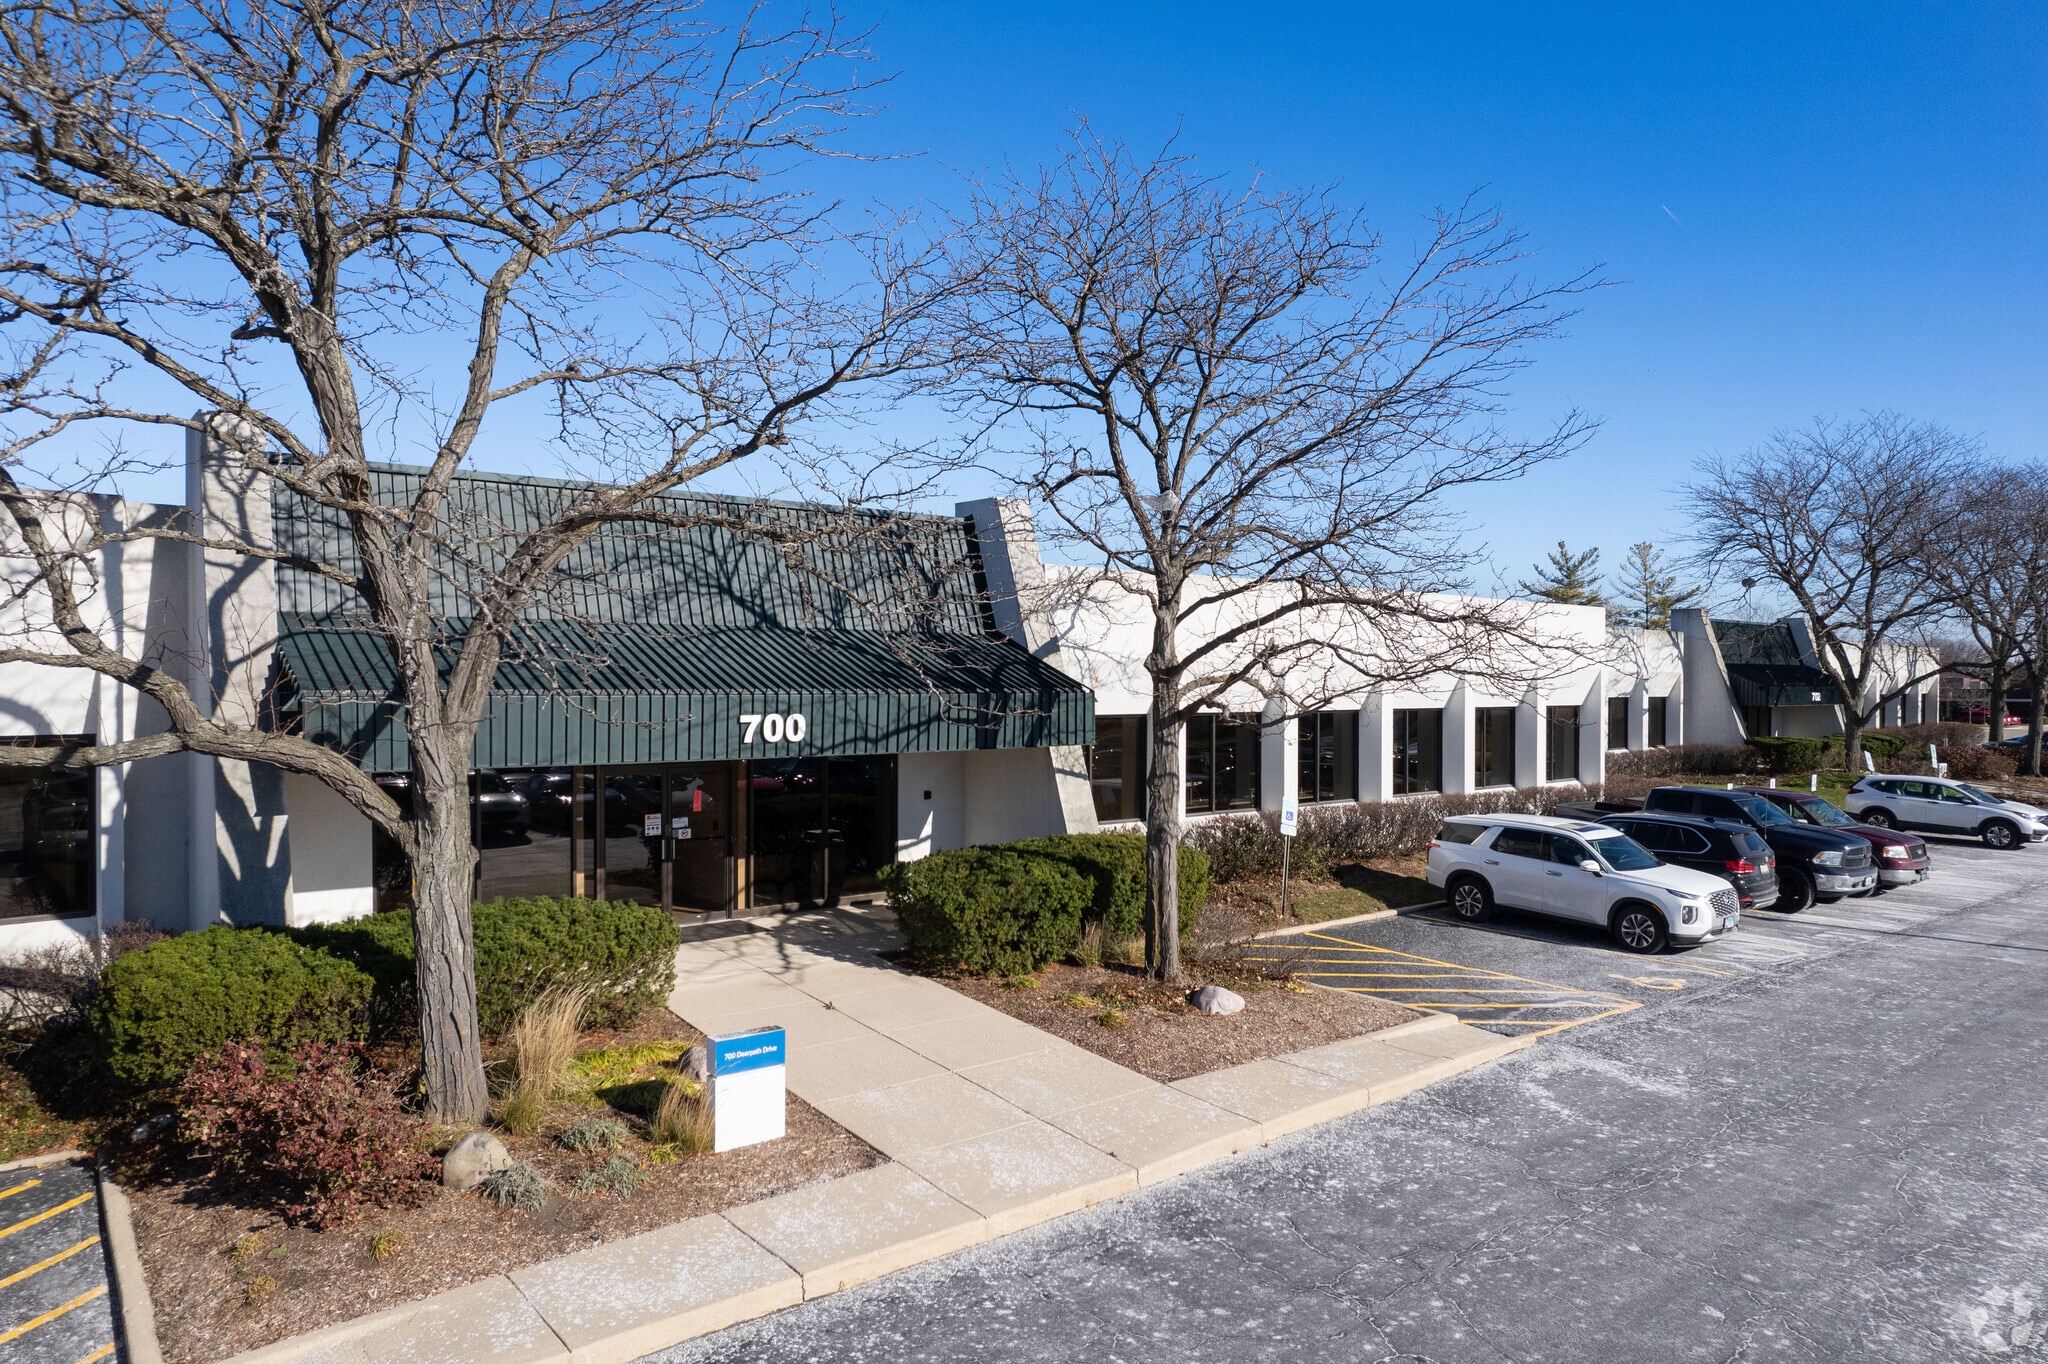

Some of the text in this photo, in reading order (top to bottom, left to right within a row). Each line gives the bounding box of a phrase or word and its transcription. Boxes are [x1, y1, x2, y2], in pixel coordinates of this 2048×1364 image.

[739, 713, 806, 743] 700
[724, 1045, 778, 1061] 700 Deerpath Drive
